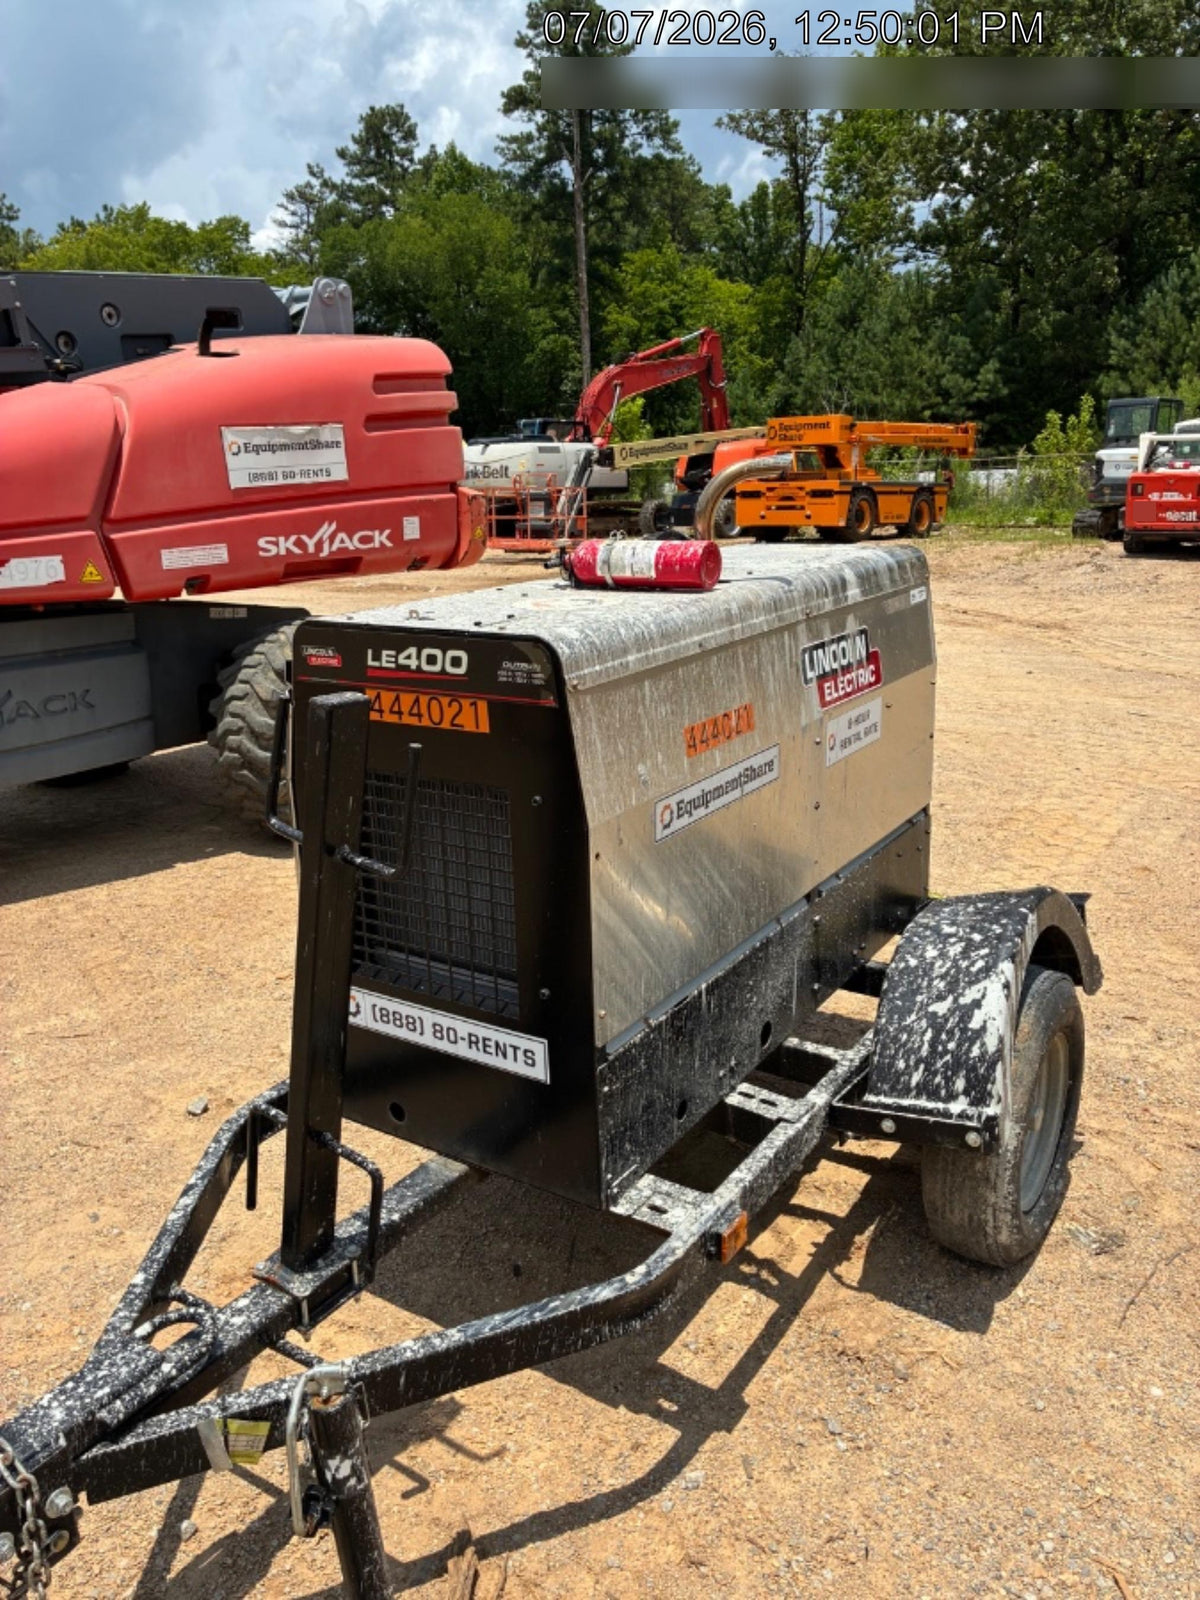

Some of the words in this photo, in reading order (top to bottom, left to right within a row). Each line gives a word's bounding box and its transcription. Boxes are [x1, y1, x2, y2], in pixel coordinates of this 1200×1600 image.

[242, 439, 342, 455] EquipmentShare
[465, 464, 511, 480] nk-Belt
[257, 520, 394, 557] SKYJACK
[367, 646, 469, 675] LE400
[804, 633, 868, 680] LINCOLN
[823, 664, 876, 702] ELECTRIC
[370, 690, 481, 731] 444021
[675, 759, 775, 820] EquipmentShare
[371, 1002, 425, 1037] (888)
[431, 1021, 538, 1068] 80-RENTS
